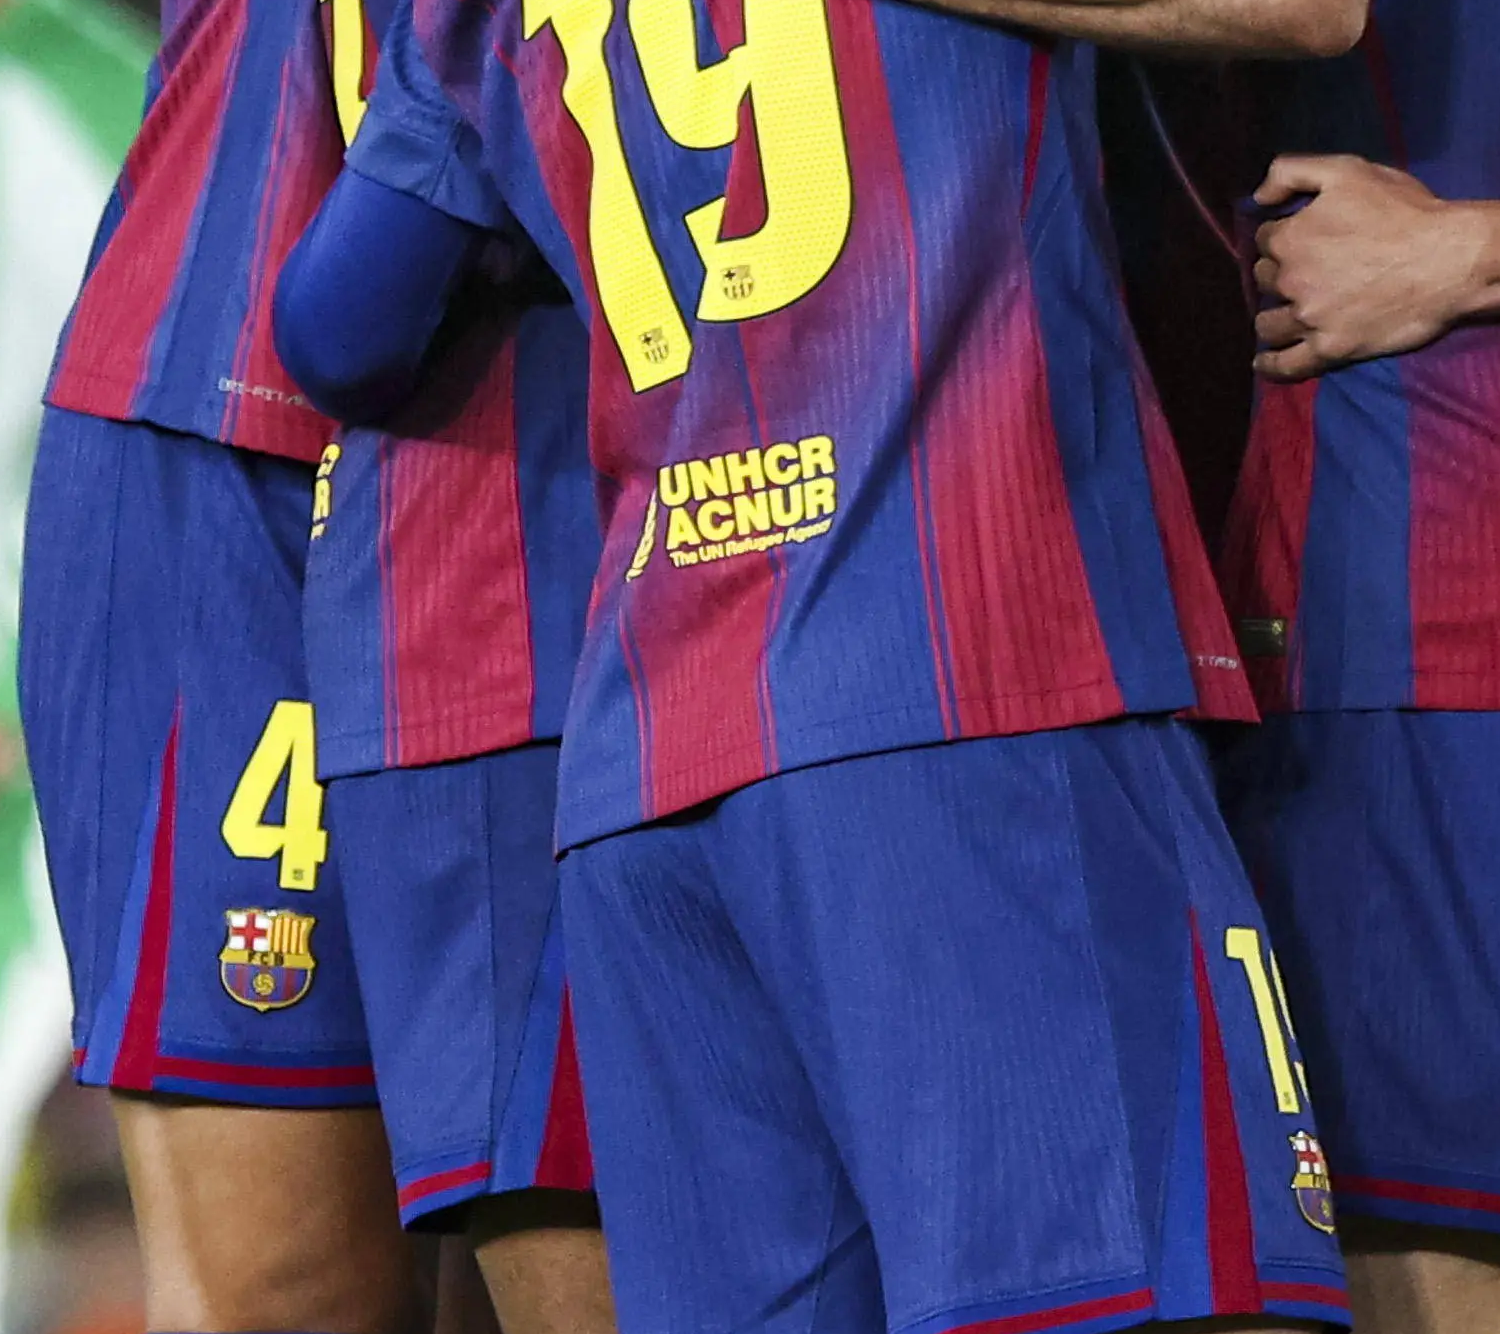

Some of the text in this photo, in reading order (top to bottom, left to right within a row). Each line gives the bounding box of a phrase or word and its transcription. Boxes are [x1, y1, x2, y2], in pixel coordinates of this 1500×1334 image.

[658, 435, 835, 506] UNHCR
[666, 477, 836, 550] ACNUR
[222, 700, 327, 891] 4
